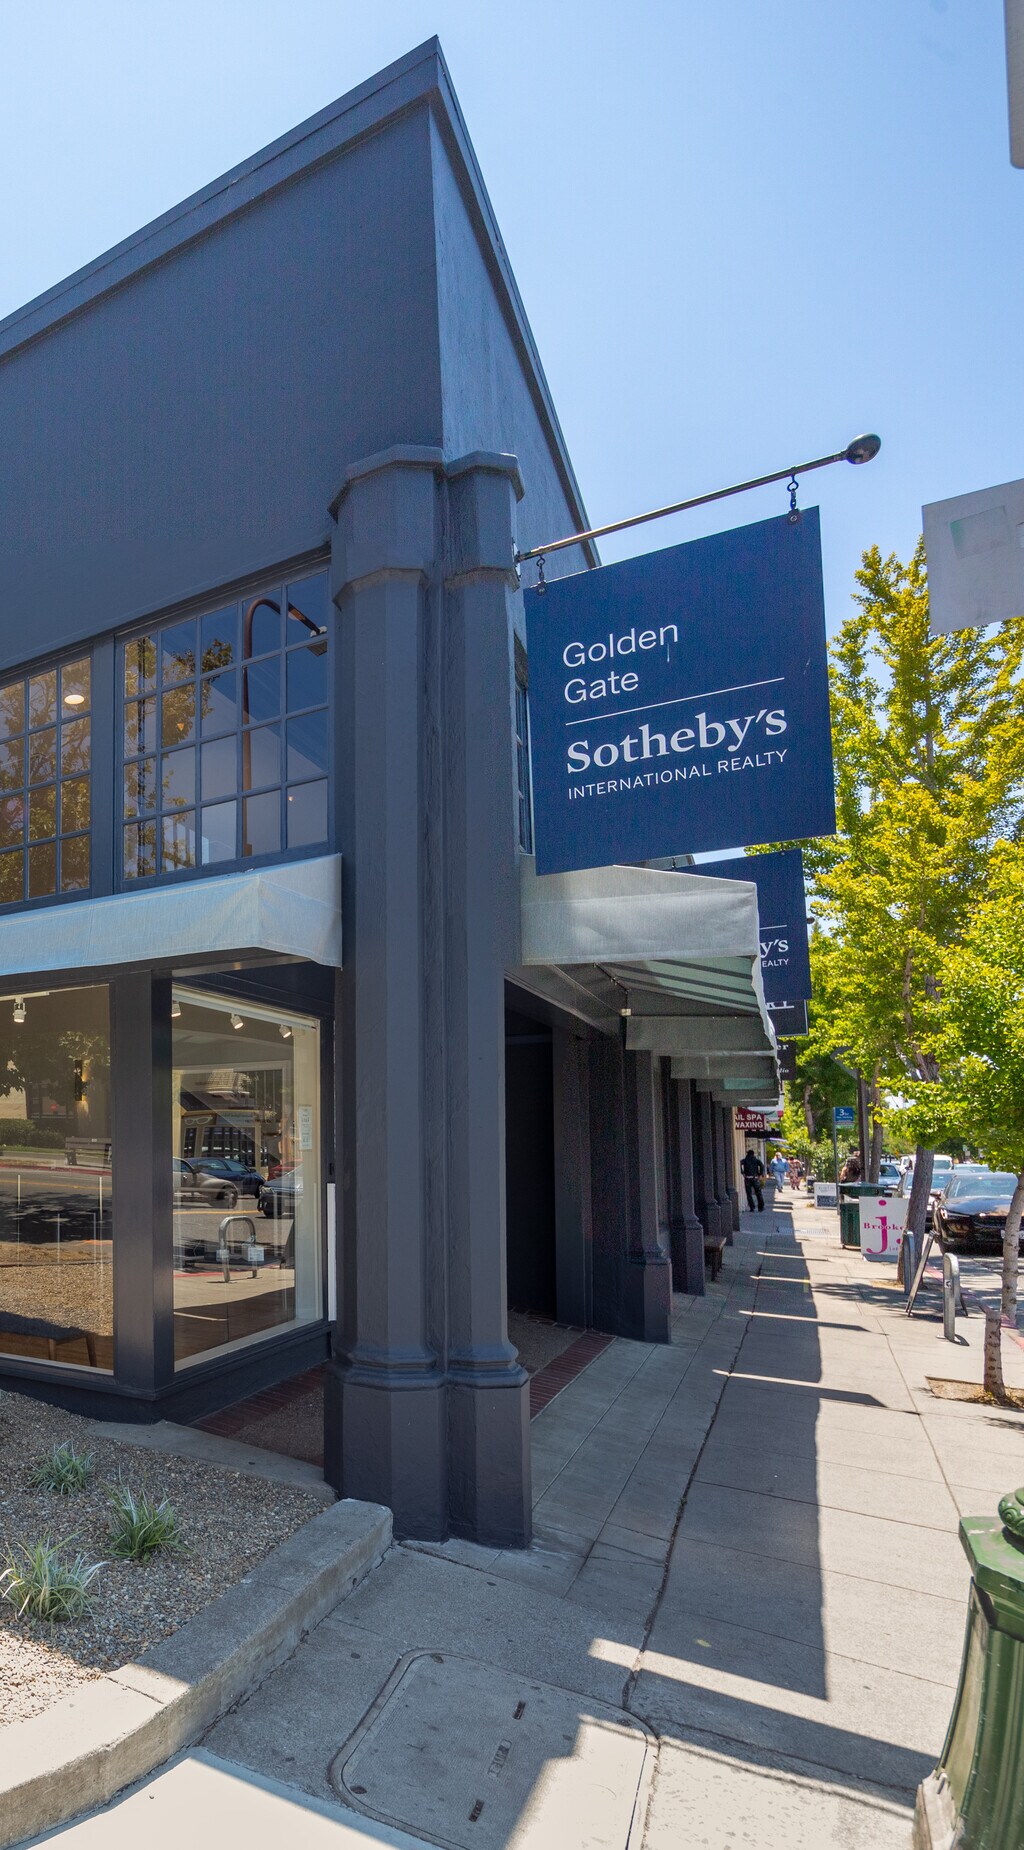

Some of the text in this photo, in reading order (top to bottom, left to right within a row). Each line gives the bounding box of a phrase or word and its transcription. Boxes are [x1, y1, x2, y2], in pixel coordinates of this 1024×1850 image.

[562, 624, 678, 668] Golden
[564, 671, 639, 704] Gate
[567, 709, 788, 774] Sotheby's
[568, 749, 788, 800] INTERNATIONAL REALTY
[746, 1113, 762, 1121] SPA
